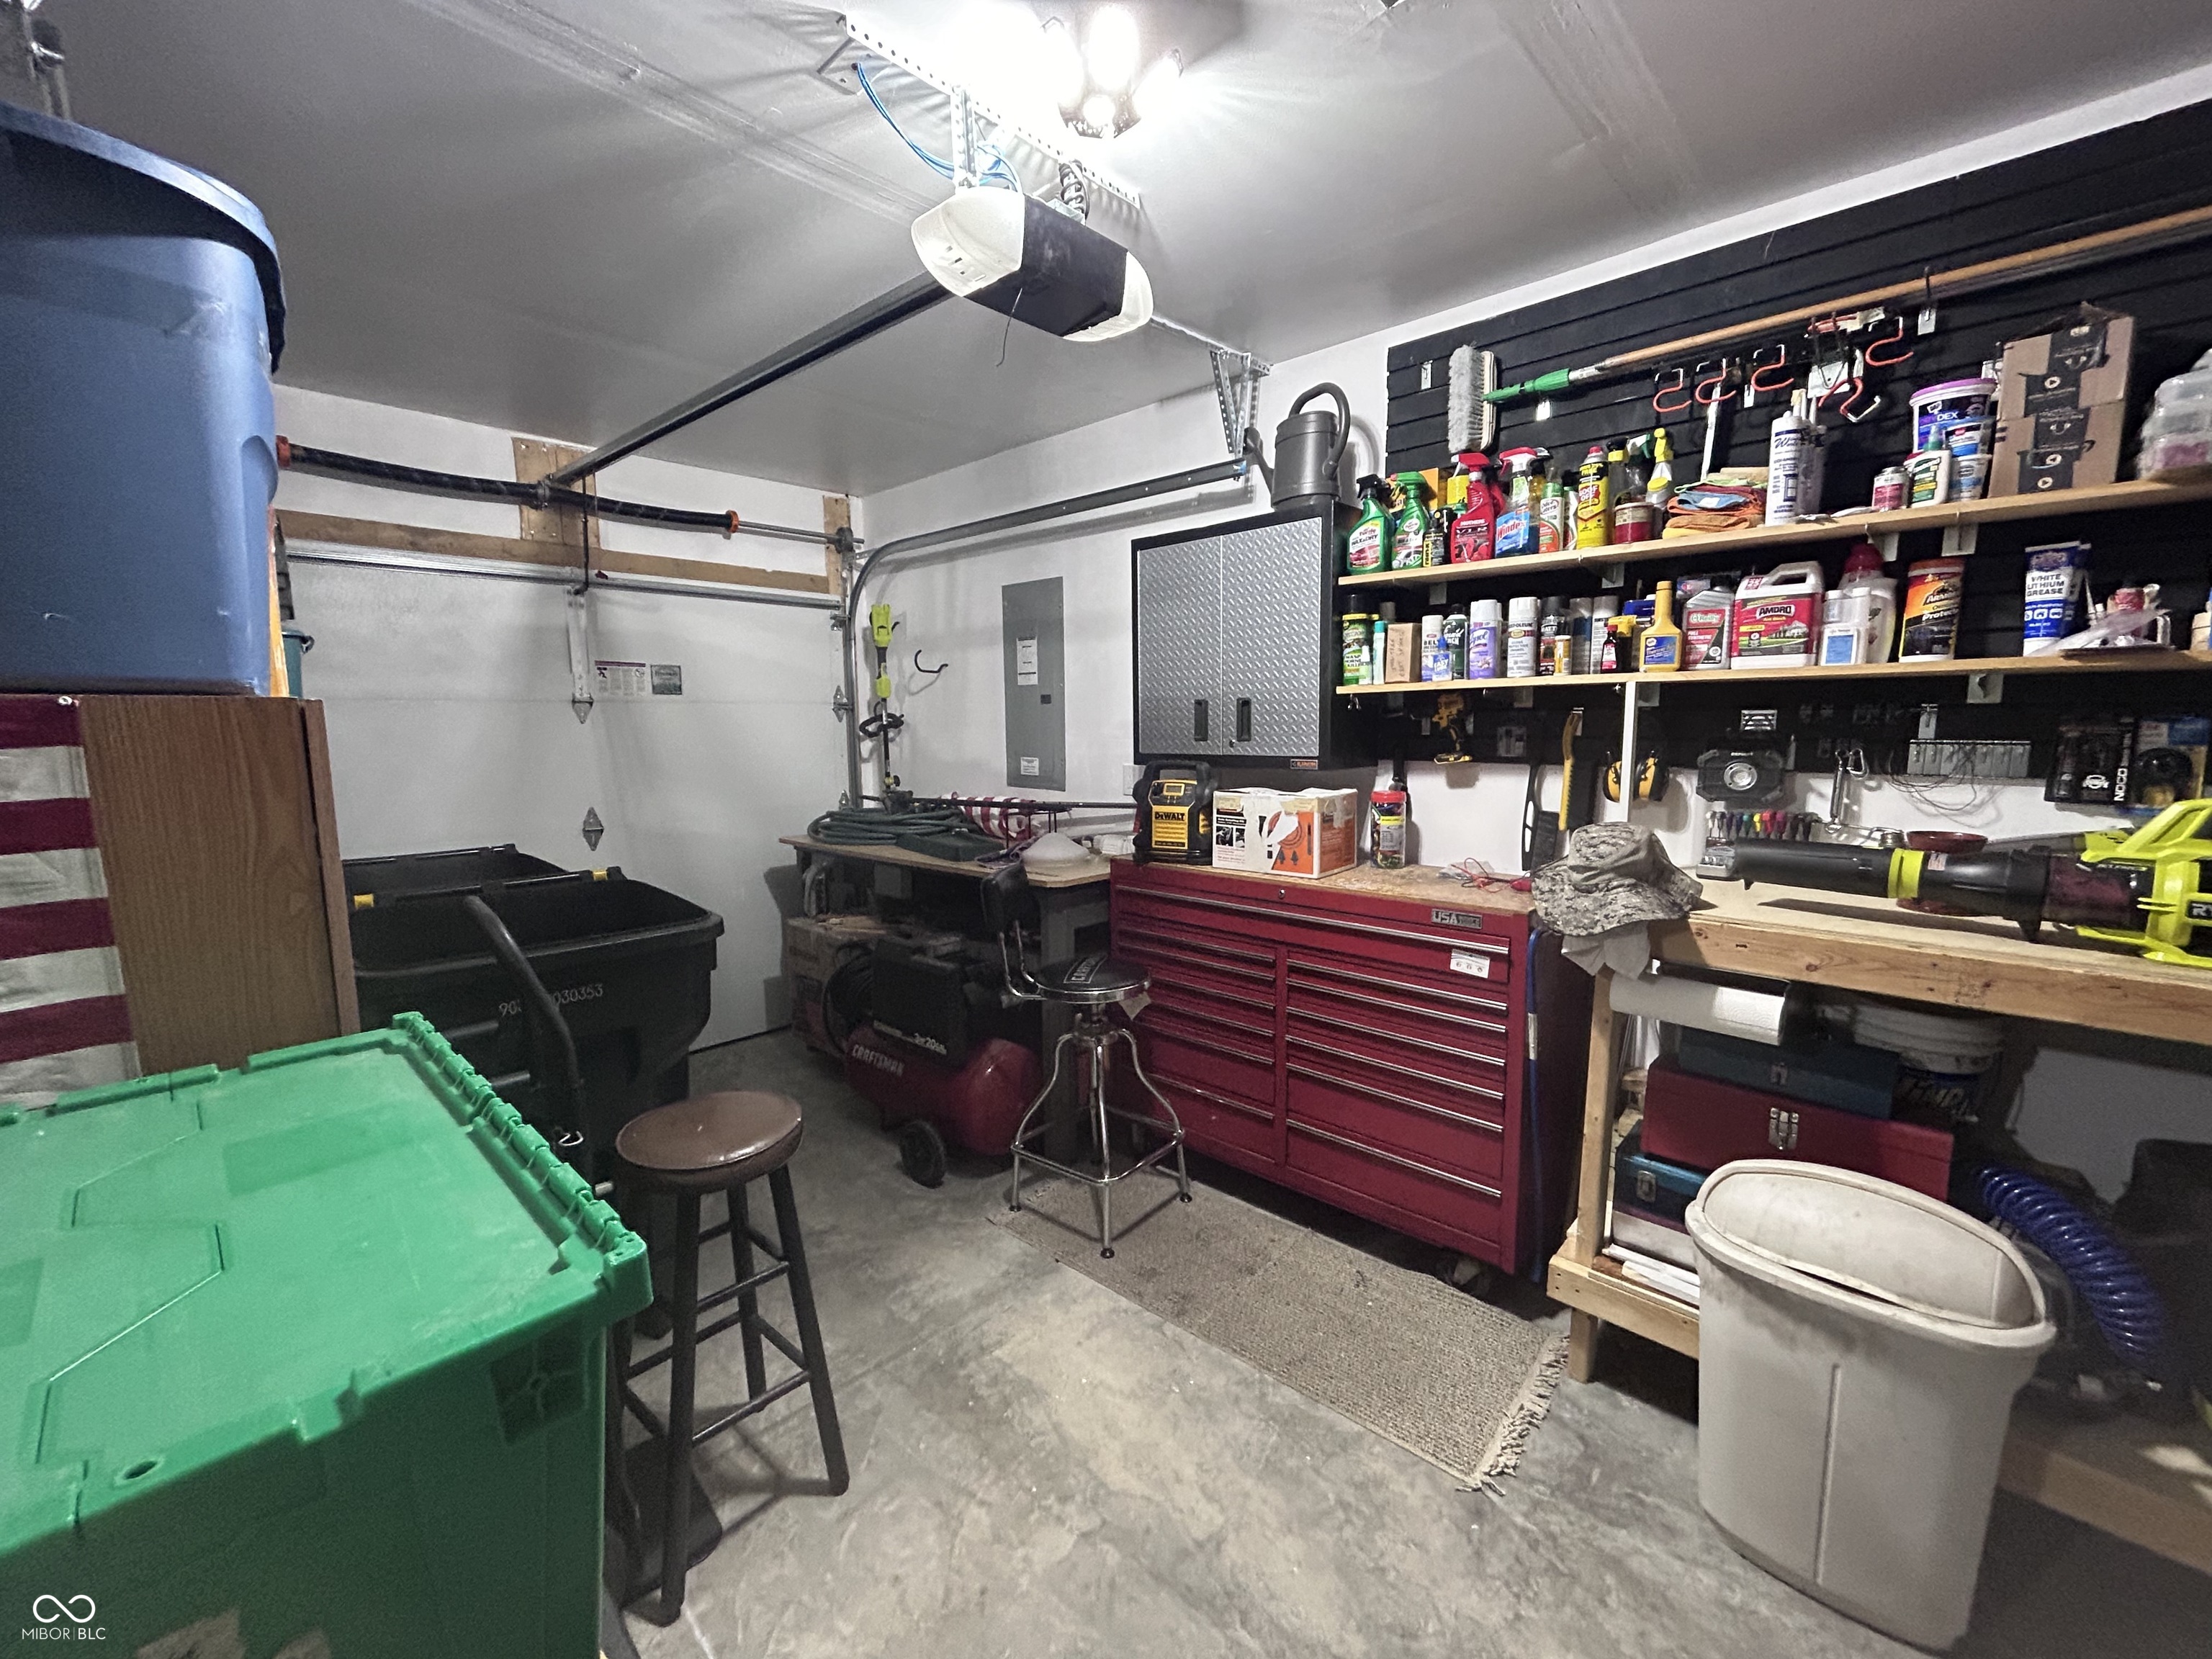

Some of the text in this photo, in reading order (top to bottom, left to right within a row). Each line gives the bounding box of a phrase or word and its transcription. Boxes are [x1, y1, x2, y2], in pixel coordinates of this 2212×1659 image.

[1497, 519, 1527, 539] Windex
[2031, 574, 2062, 583] WHITE
[2027, 580, 2065, 590] LITHIUM
[2027, 588, 2064, 597] GREASE
[1758, 606, 1792, 616] AMDRO
[2114, 768, 2128, 802] NOCO
[1433, 910, 1458, 925] USA
[852, 1043, 905, 1077] CRAFTSMAN
